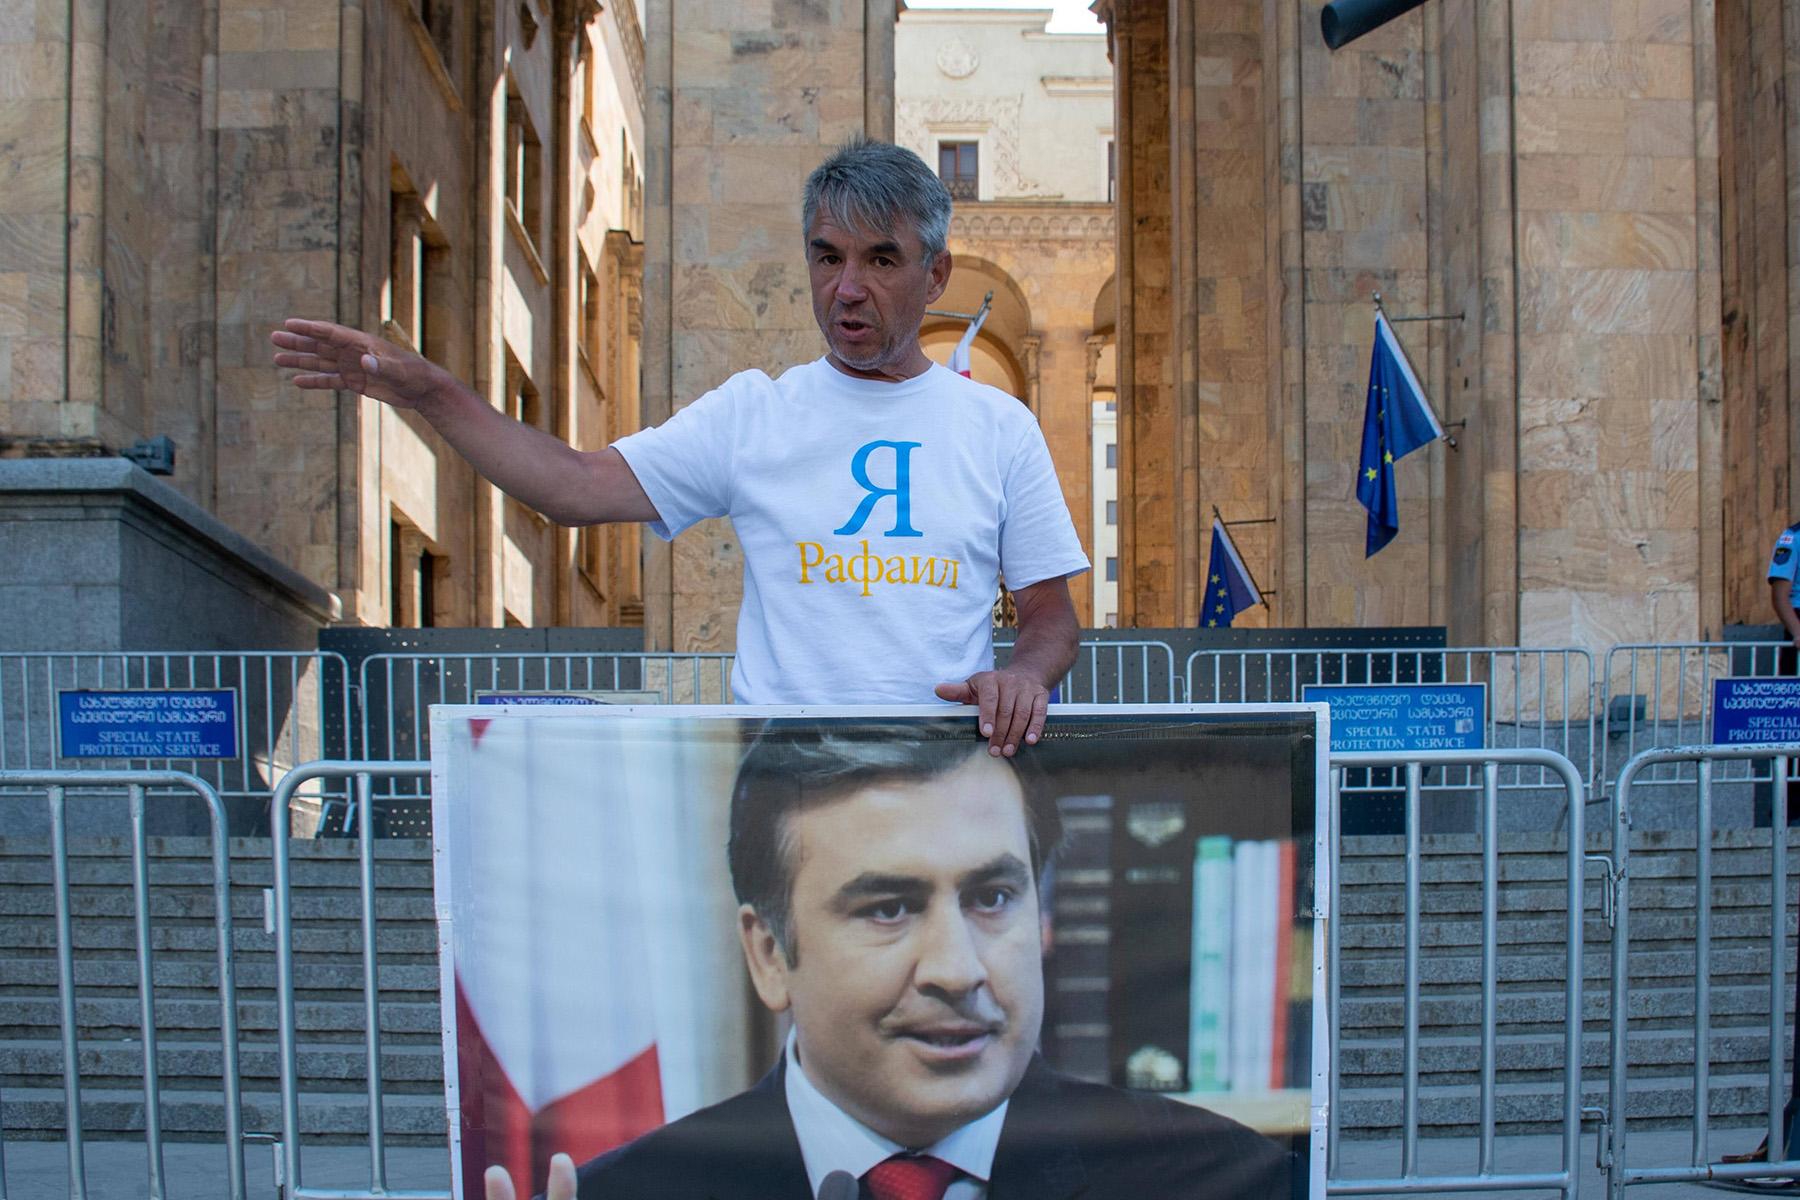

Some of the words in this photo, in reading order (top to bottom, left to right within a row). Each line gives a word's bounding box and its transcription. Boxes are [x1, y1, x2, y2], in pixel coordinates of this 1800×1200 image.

[833, 439, 924, 537] Я
[795, 539, 961, 597] Рафаил
[98, 731, 153, 743] SPECIAL
[156, 731, 201, 743] STATE
[1345, 726, 1397, 737] SPECIAL
[1406, 725, 1446, 736] STATE
[1415, 737, 1466, 748] SERVICE
[79, 744, 162, 756] PROTECTION
[165, 744, 221, 756] SERVICE
